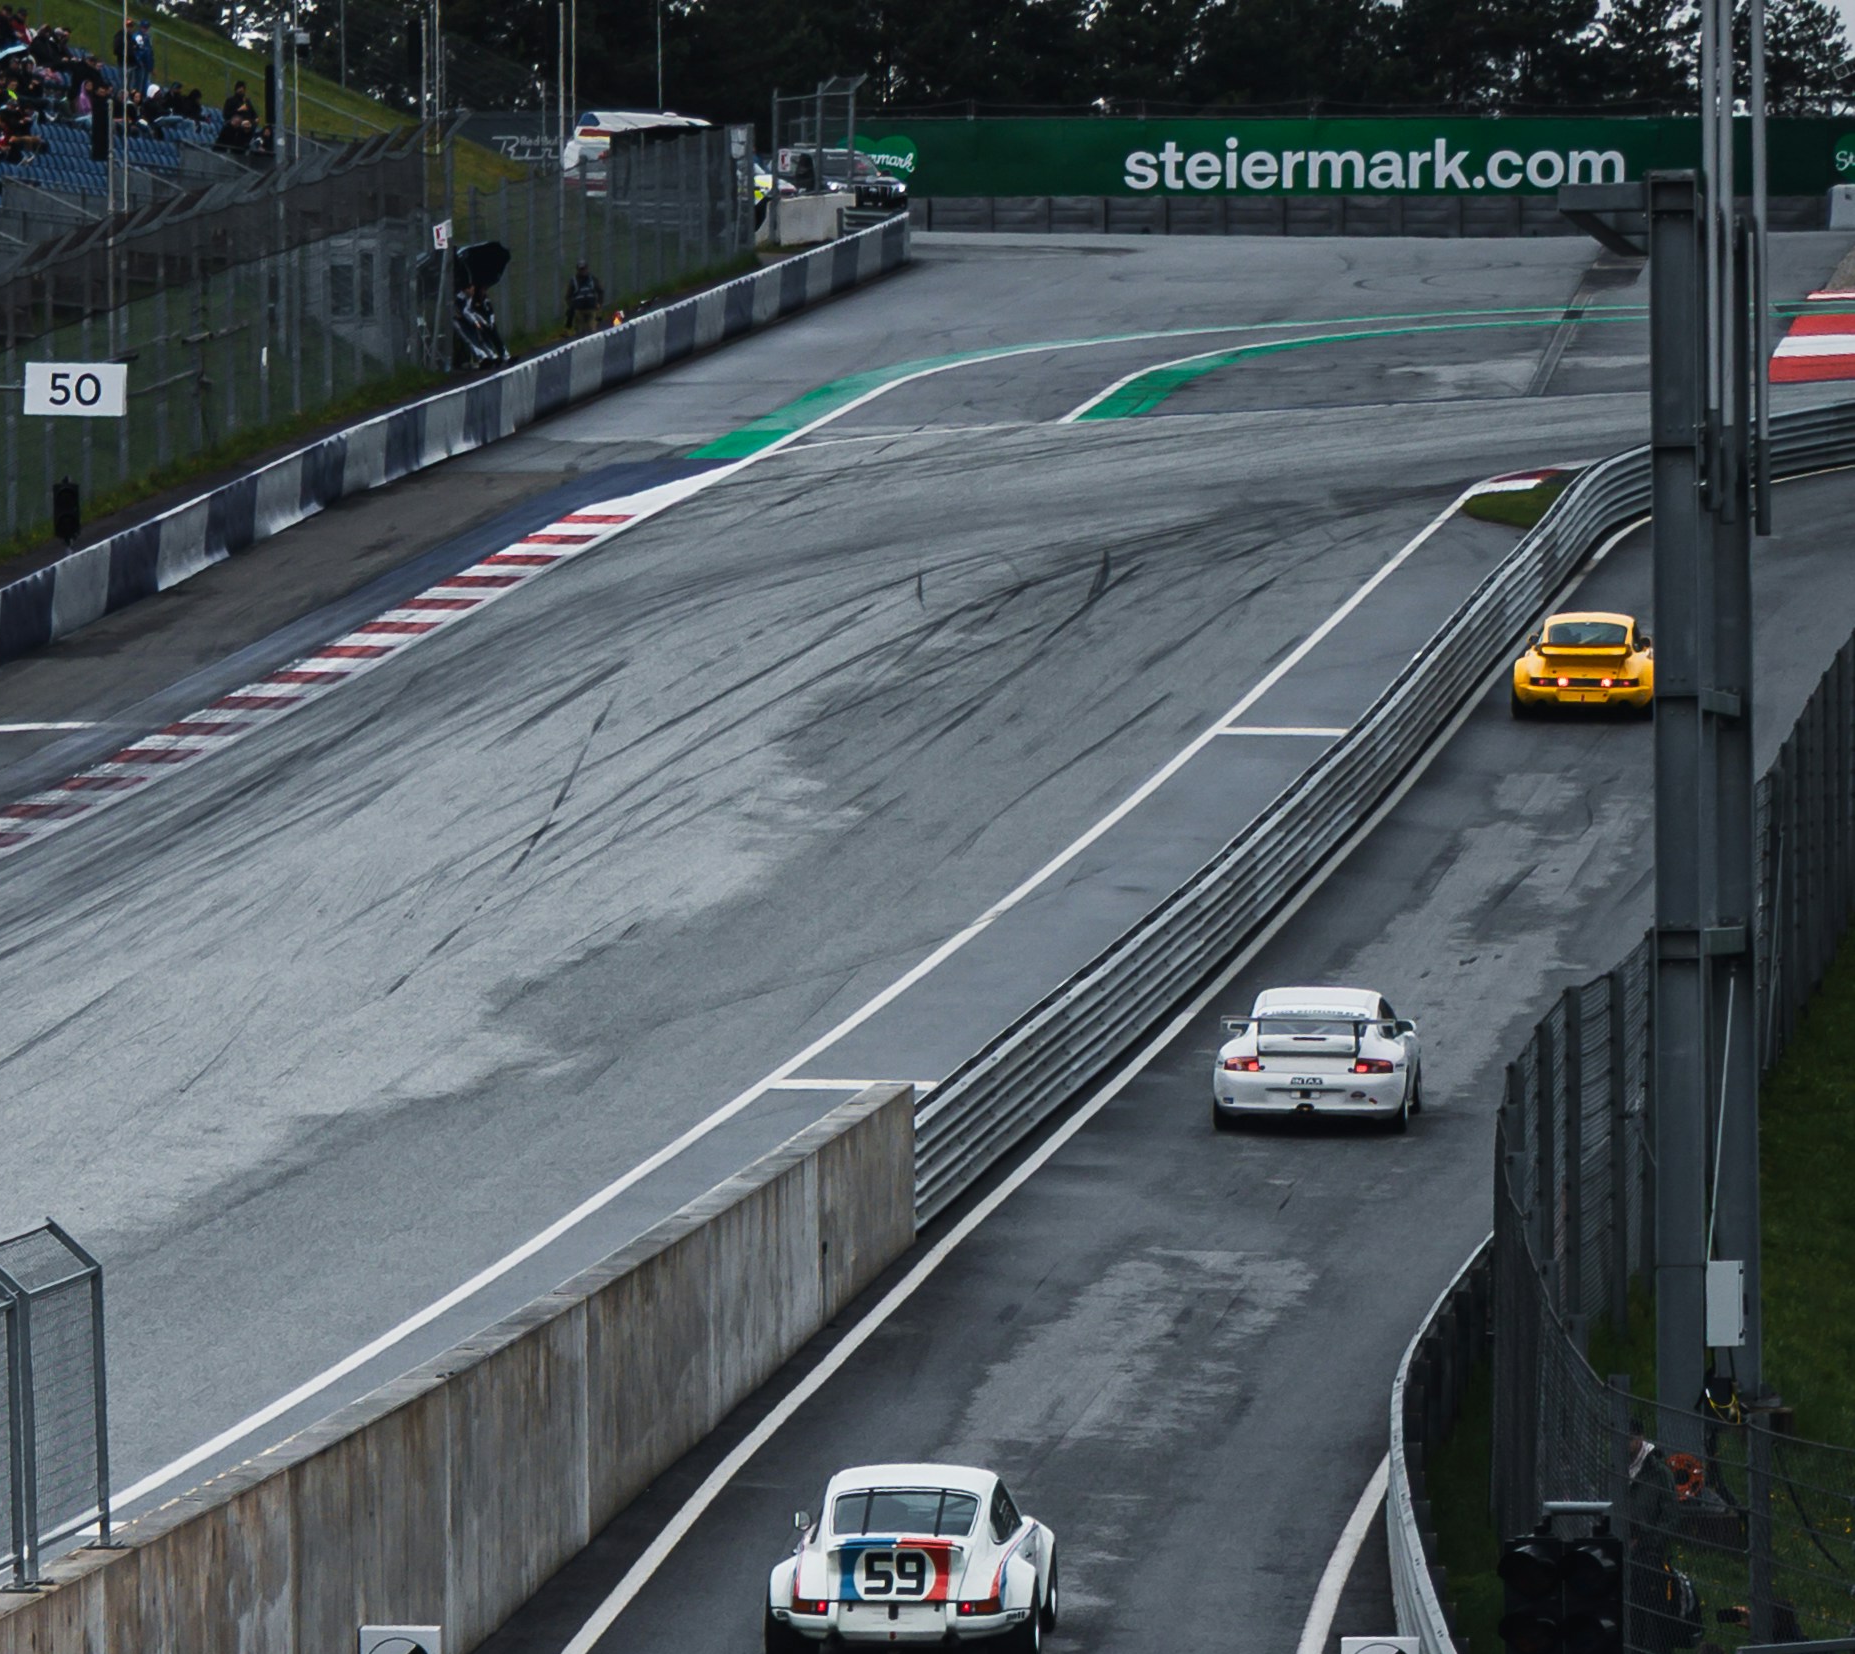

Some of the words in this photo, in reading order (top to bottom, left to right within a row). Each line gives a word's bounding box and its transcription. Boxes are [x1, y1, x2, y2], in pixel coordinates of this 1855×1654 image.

[1124, 137, 1626, 190] steiermark.com
[49, 372, 102, 407] 50
[864, 1551, 926, 1596] 59
